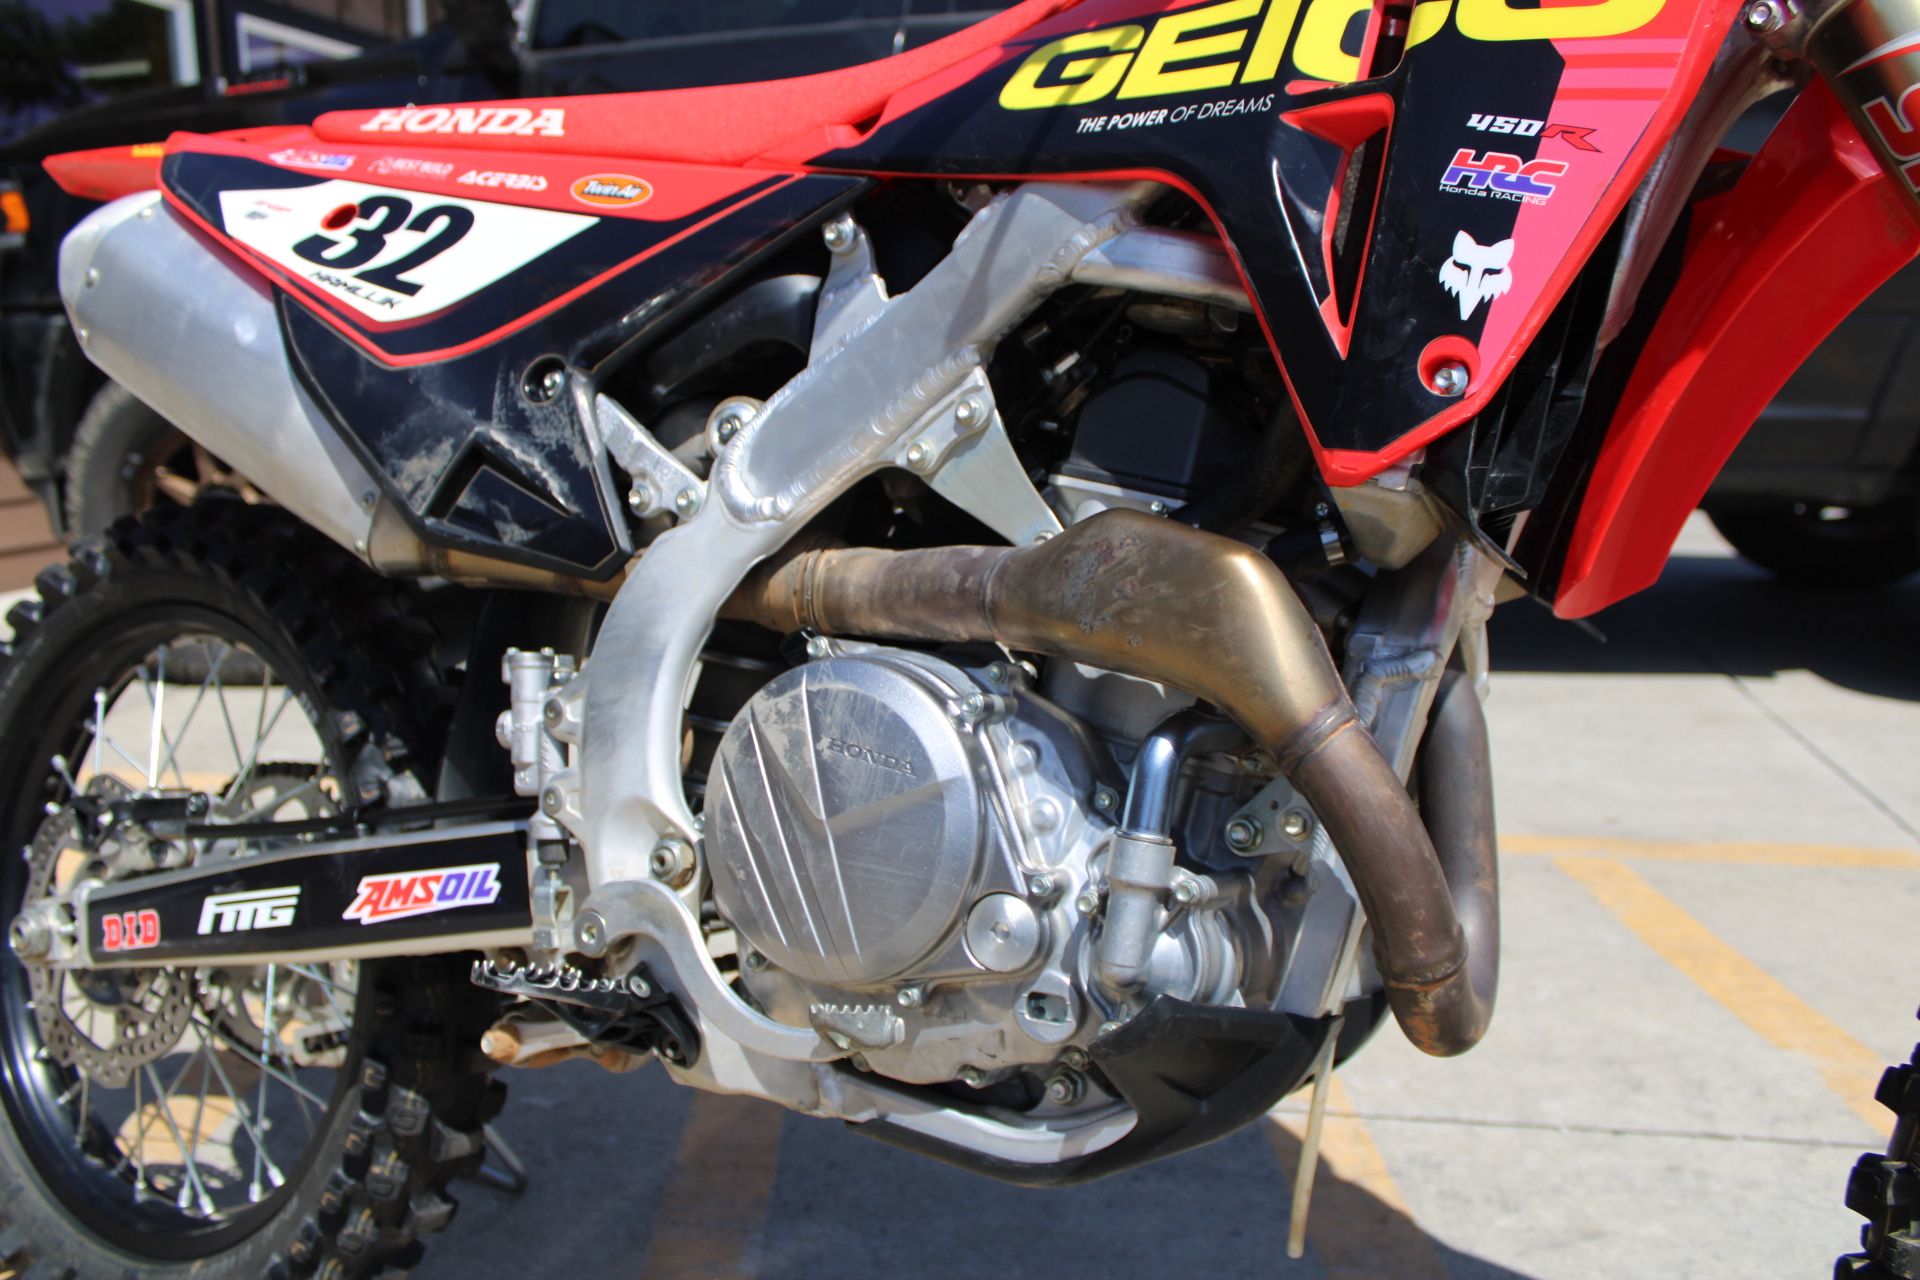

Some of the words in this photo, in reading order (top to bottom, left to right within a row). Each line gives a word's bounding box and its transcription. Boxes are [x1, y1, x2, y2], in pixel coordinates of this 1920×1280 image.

[360, 108, 566, 137] HONDA
[1076, 117, 1107, 134] THE
[1106, 108, 1169, 131] POWER
[1170, 104, 1198, 123] OF
[1197, 93, 1275, 120] DREAMS
[582, 179, 619, 199] Twin
[616, 183, 644, 201] Air
[1440, 148, 1569, 197] HRC
[1439, 183, 1488, 198] Honda
[1490, 190, 1547, 206] RACING
[292, 195, 475, 297] 32
[826, 737, 918, 780] HONDA
[346, 865, 499, 922] AMSOIL
